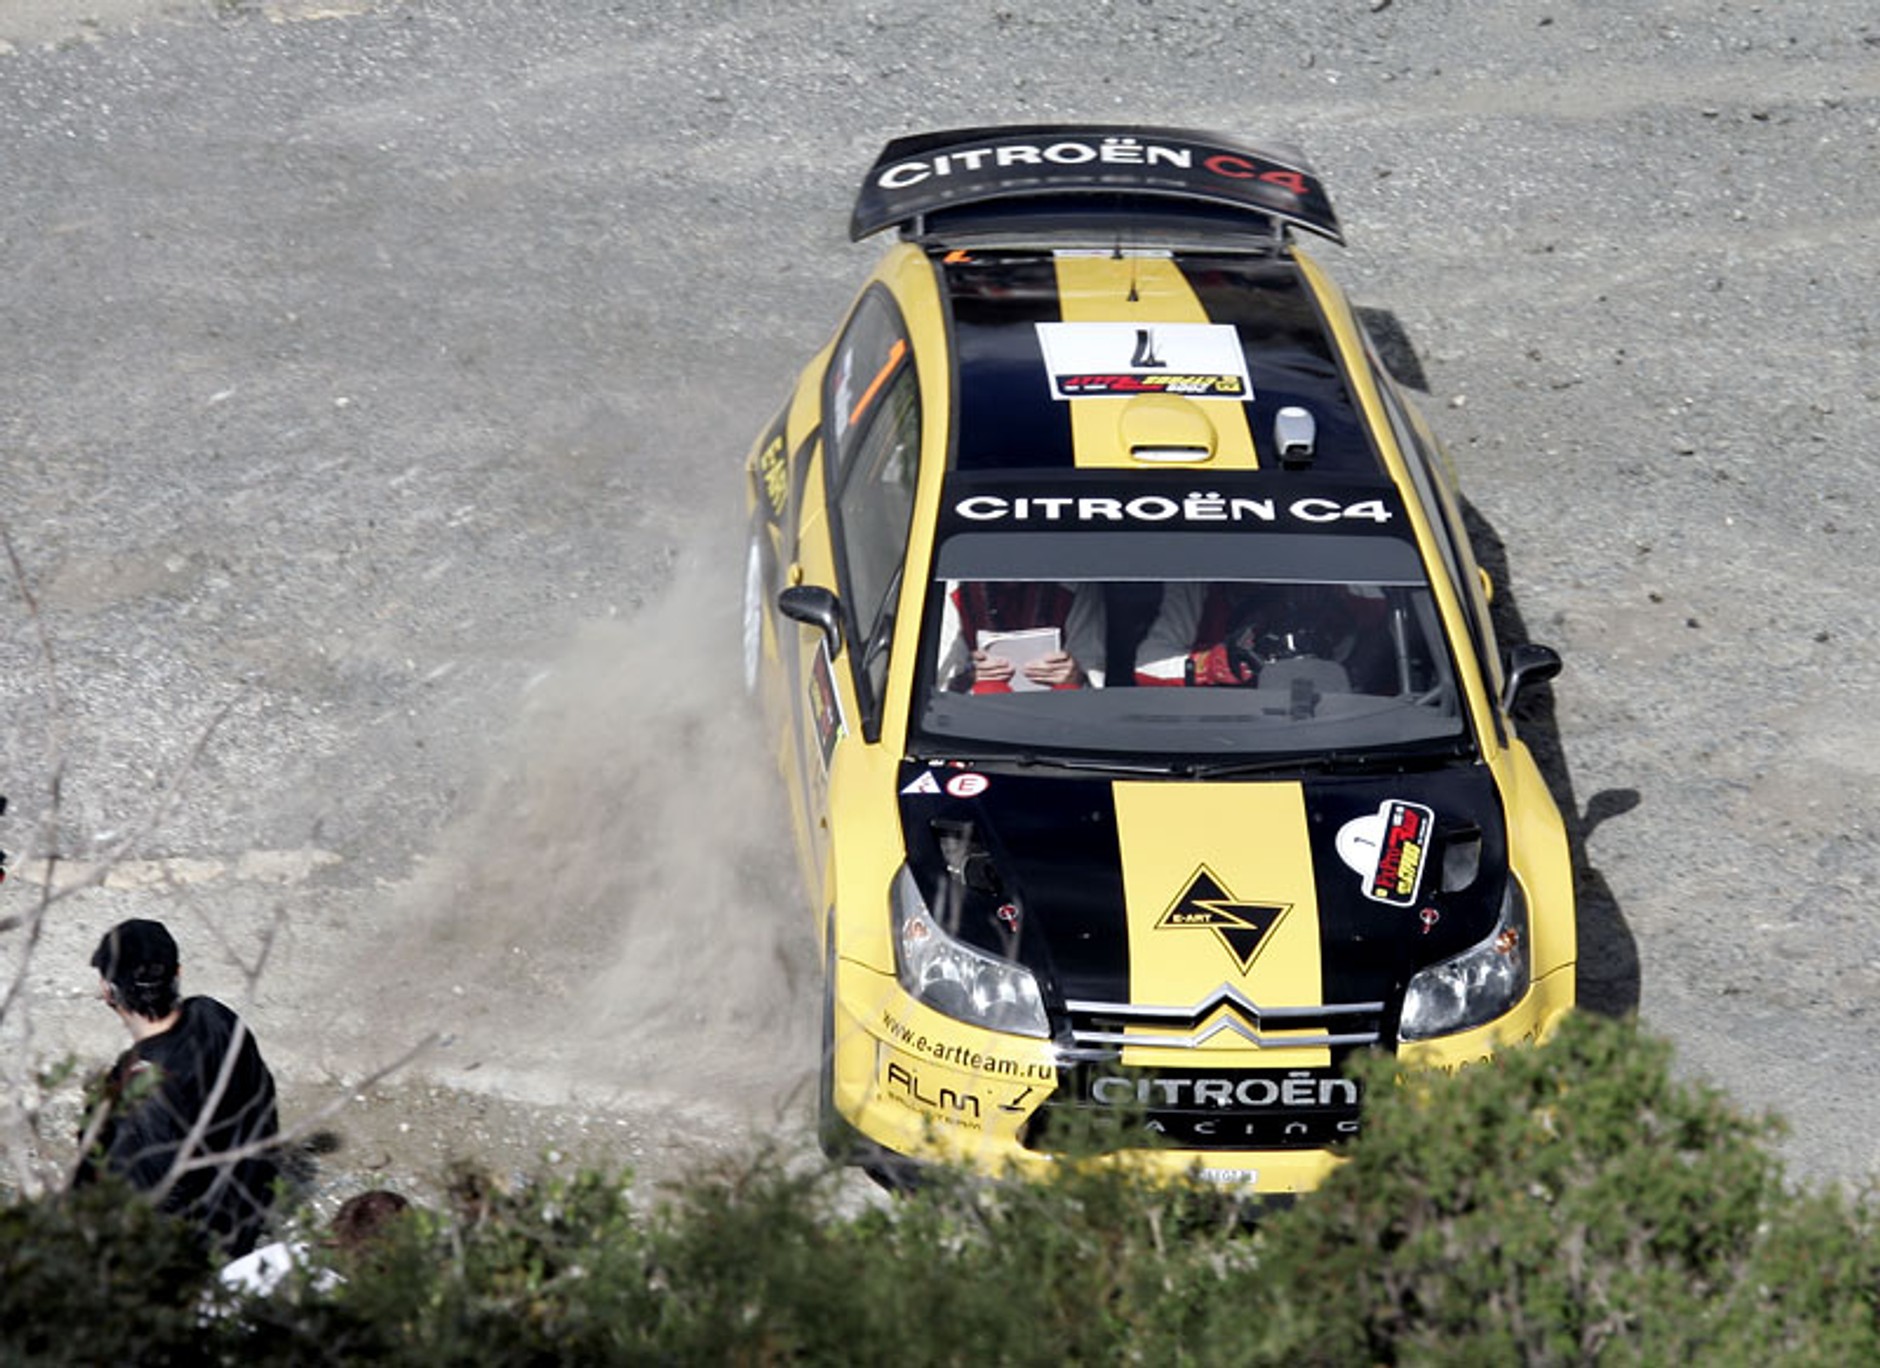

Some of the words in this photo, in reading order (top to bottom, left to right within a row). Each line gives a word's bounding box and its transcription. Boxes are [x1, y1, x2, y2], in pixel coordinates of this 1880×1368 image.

[876, 137, 1191, 190] CITROËN
[1203, 155, 1309, 194] C4
[955, 491, 1276, 522] CITROËN
[1289, 499, 1393, 523] C4
[883, 1009, 1052, 1081] www.e-artteam.ru
[1092, 1071, 1358, 1106] CITROËN
